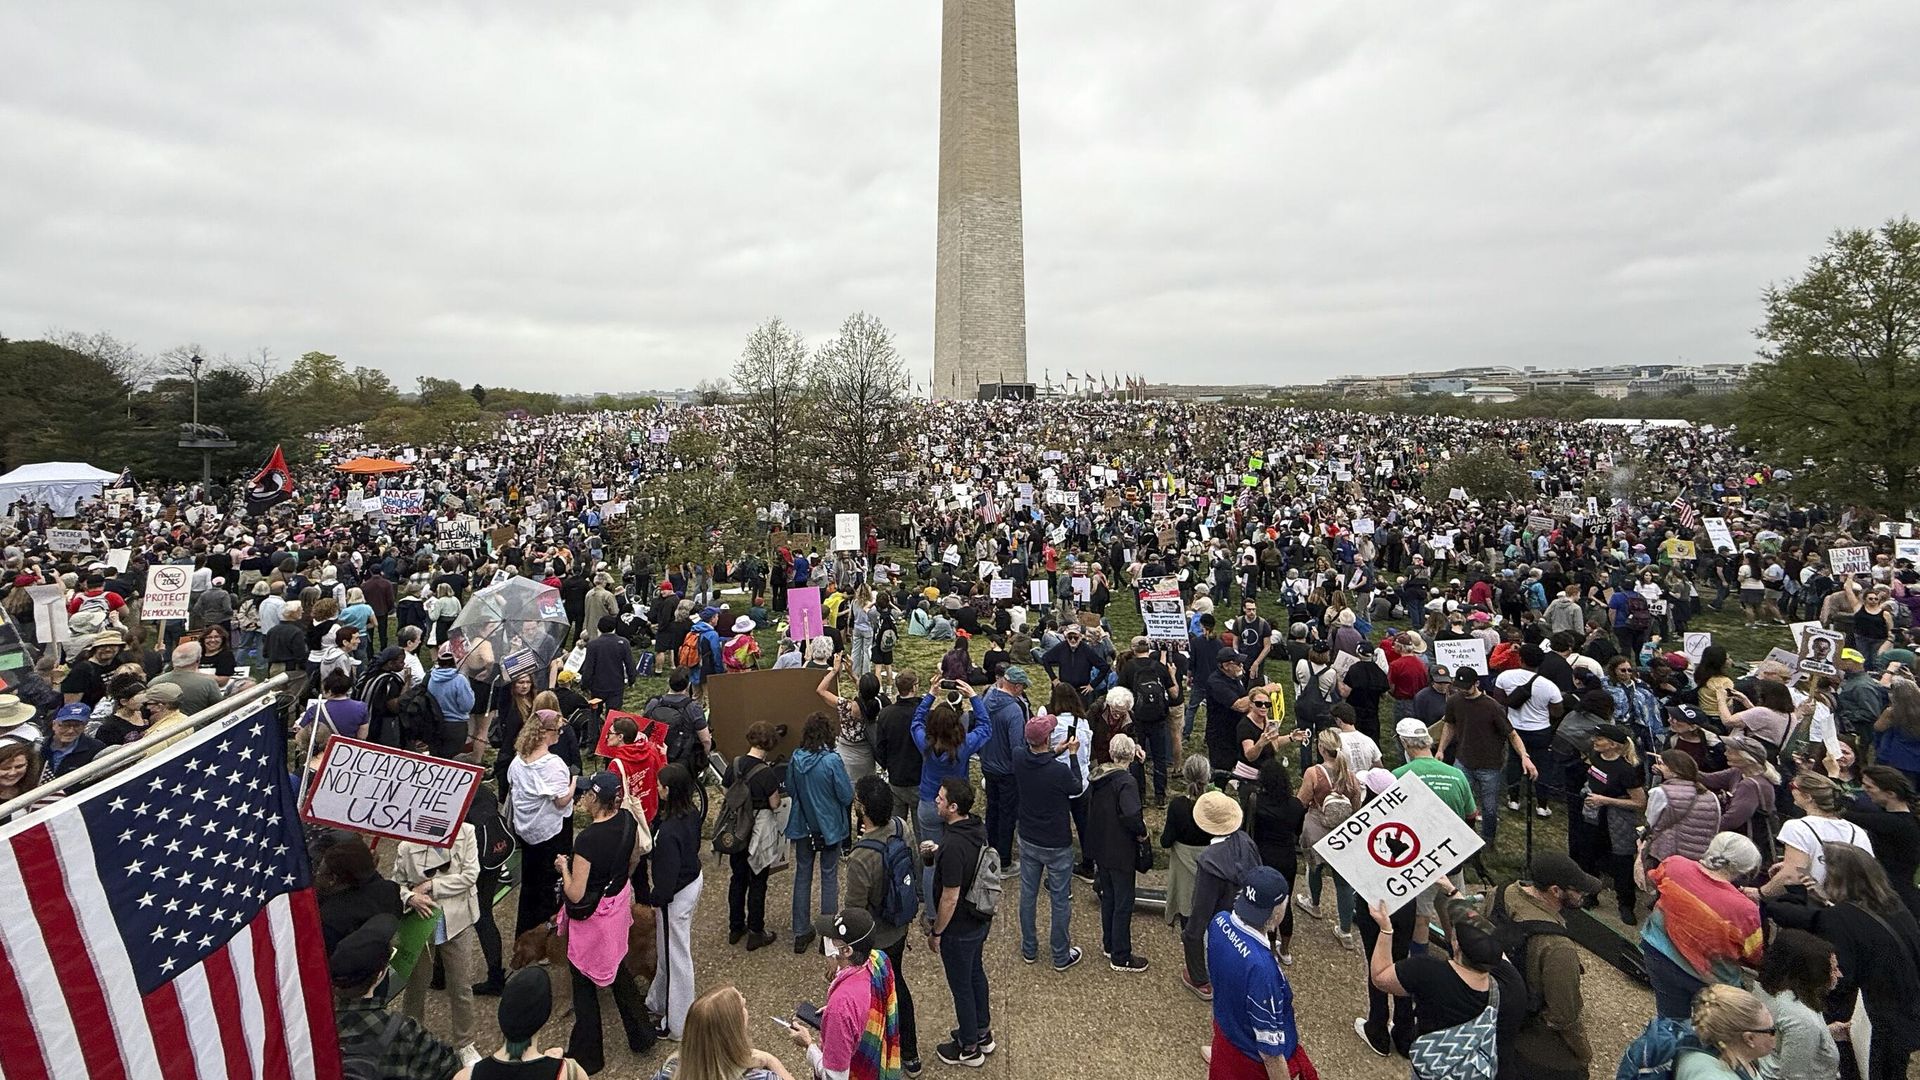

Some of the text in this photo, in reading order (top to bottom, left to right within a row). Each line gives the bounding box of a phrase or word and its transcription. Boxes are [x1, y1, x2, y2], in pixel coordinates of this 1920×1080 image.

[384, 491, 418, 499] MAKE
[1585, 516, 1611, 526] HANDS
[1590, 524, 1607, 534] OFF
[440, 540, 459, 549] LIKE
[1847, 548, 1866, 556] NOT
[1840, 562, 1860, 574] JOIN
[1860, 561, 1870, 572] US
[145, 592, 189, 602] PROTECT
[142, 608, 188, 617] DEMOCRACY
[330, 744, 473, 793] DICTATORSHIP
[320, 768, 453, 814] NOT IN THE
[347, 797, 412, 832] USA
[1327, 786, 1409, 852] STOP THE
[1386, 837, 1459, 898] GRIFT
[1221, 923, 1251, 959] CABHÁN
